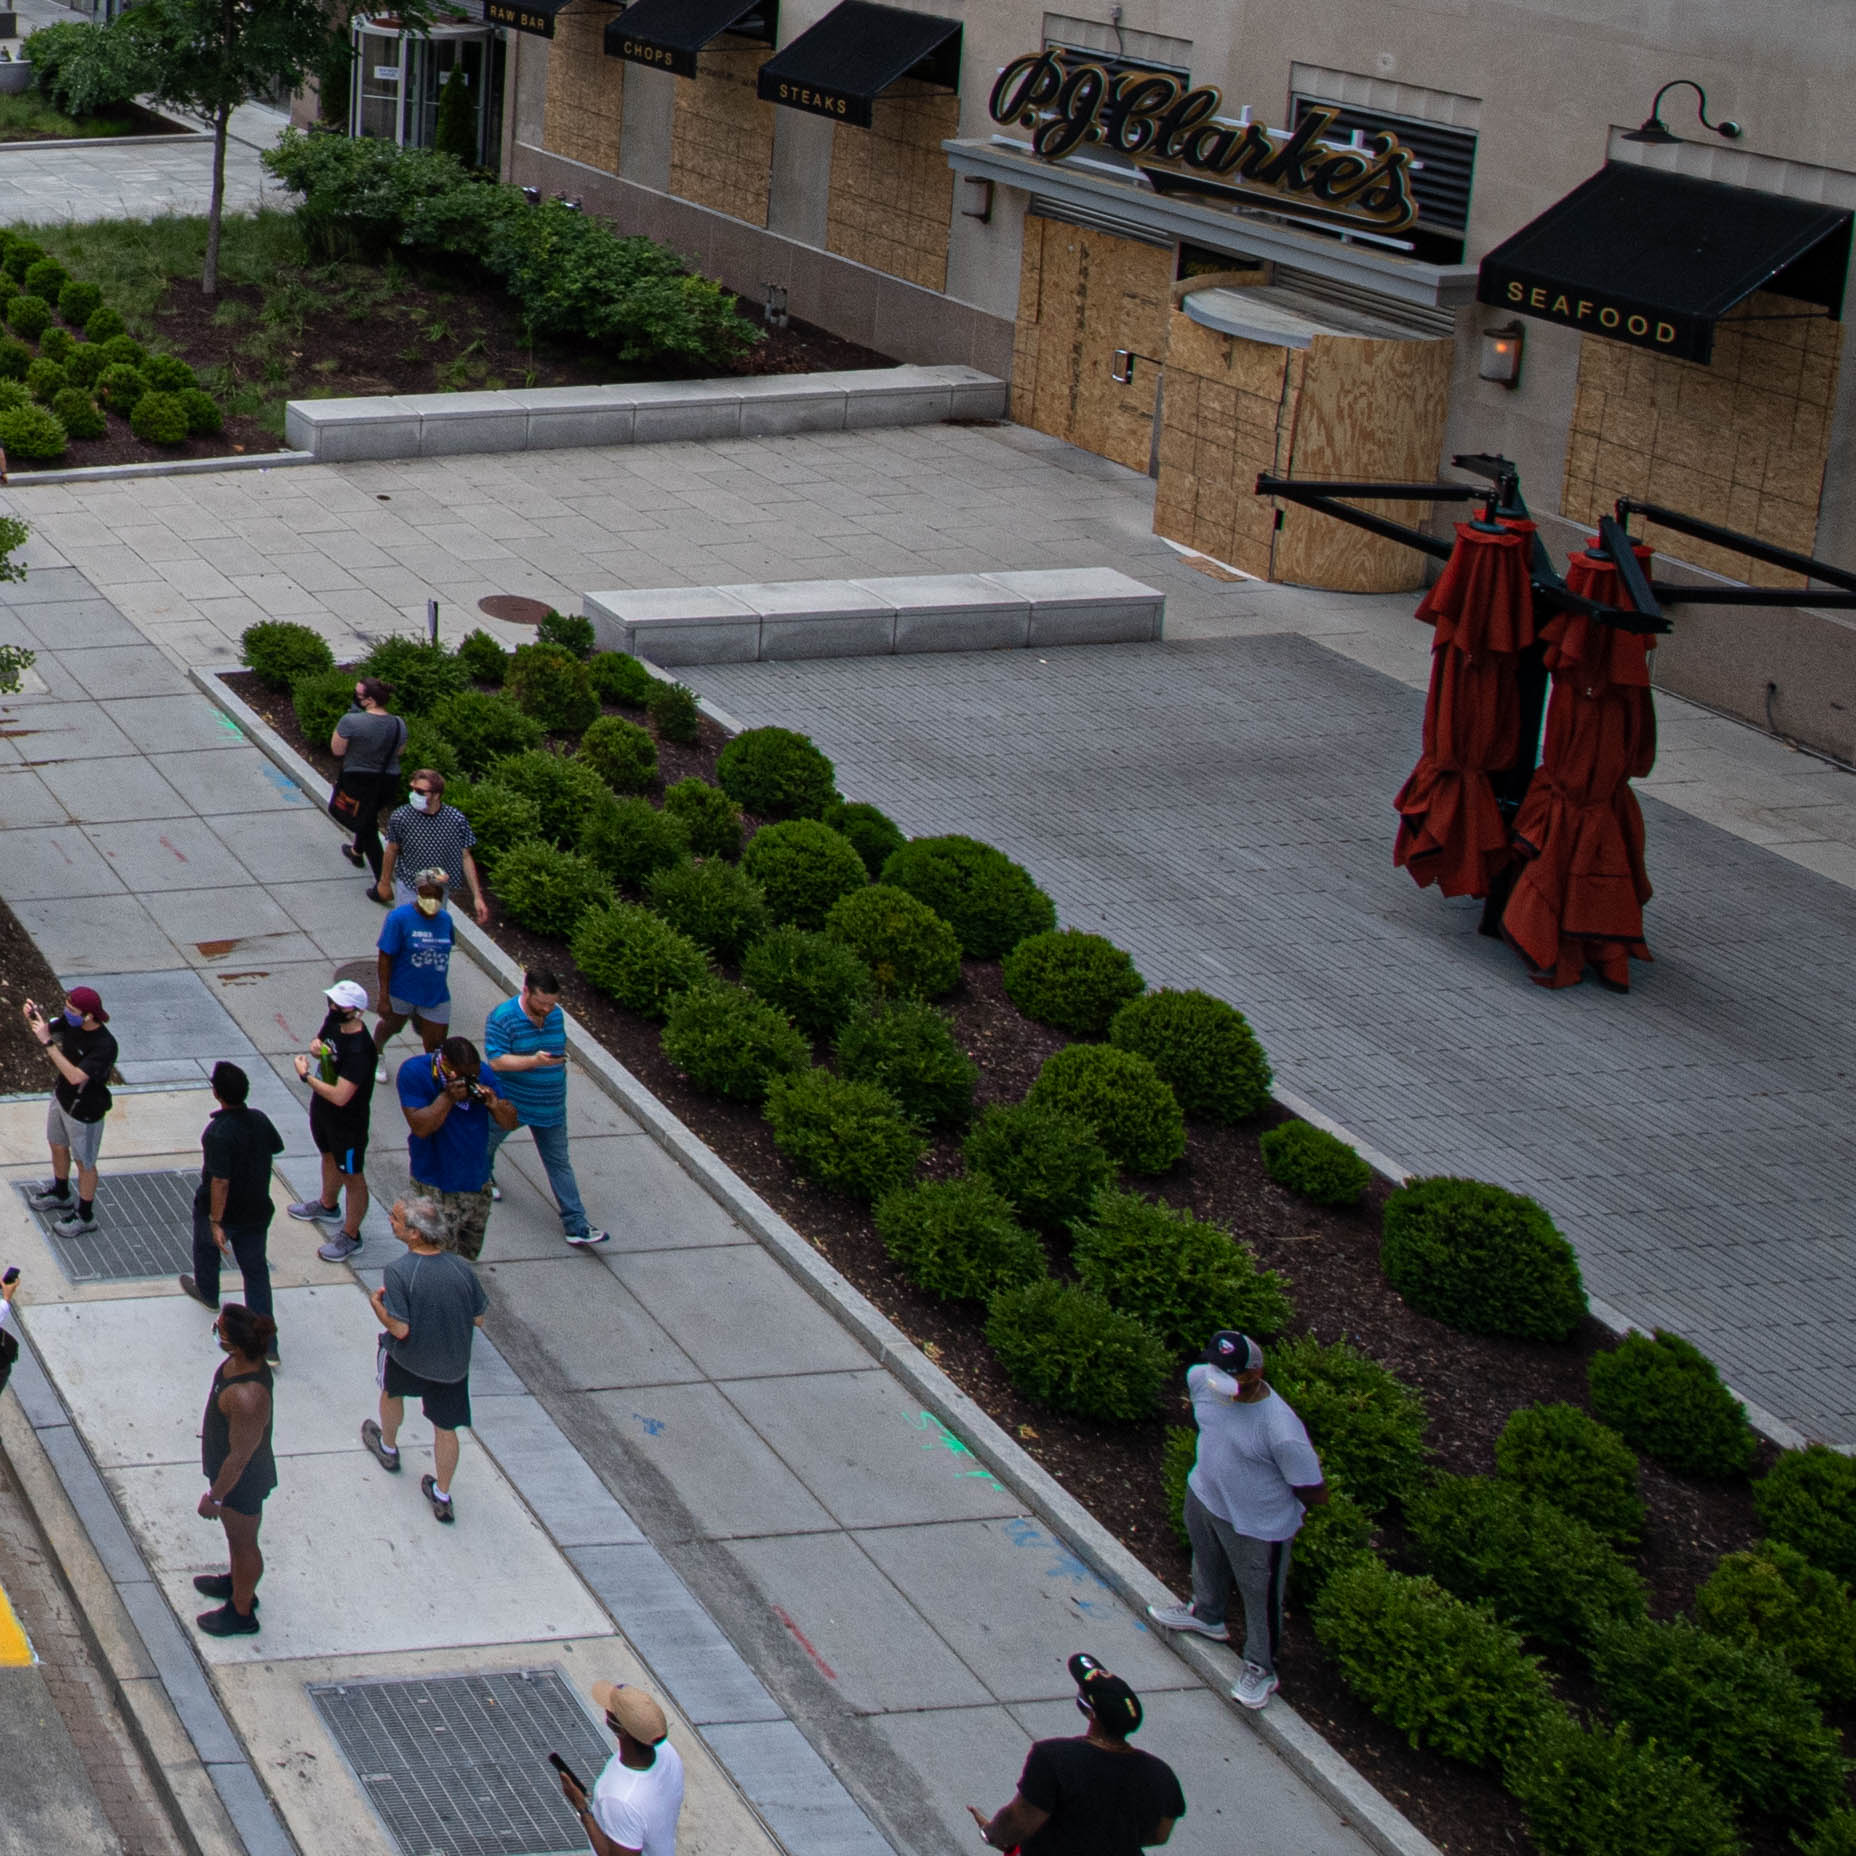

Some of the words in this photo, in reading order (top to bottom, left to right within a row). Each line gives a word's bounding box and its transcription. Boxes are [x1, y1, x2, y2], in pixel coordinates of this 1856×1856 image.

[490, 4, 515, 23] RAW
[520, 14, 545, 30] BAR
[623, 41, 673, 66] CHOPS
[779, 83, 847, 114] STEAKS
[988, 47, 1109, 162] P.J.
[1108, 70, 1419, 232] Clarke's
[1506, 281, 1677, 343] SEAFOOD
